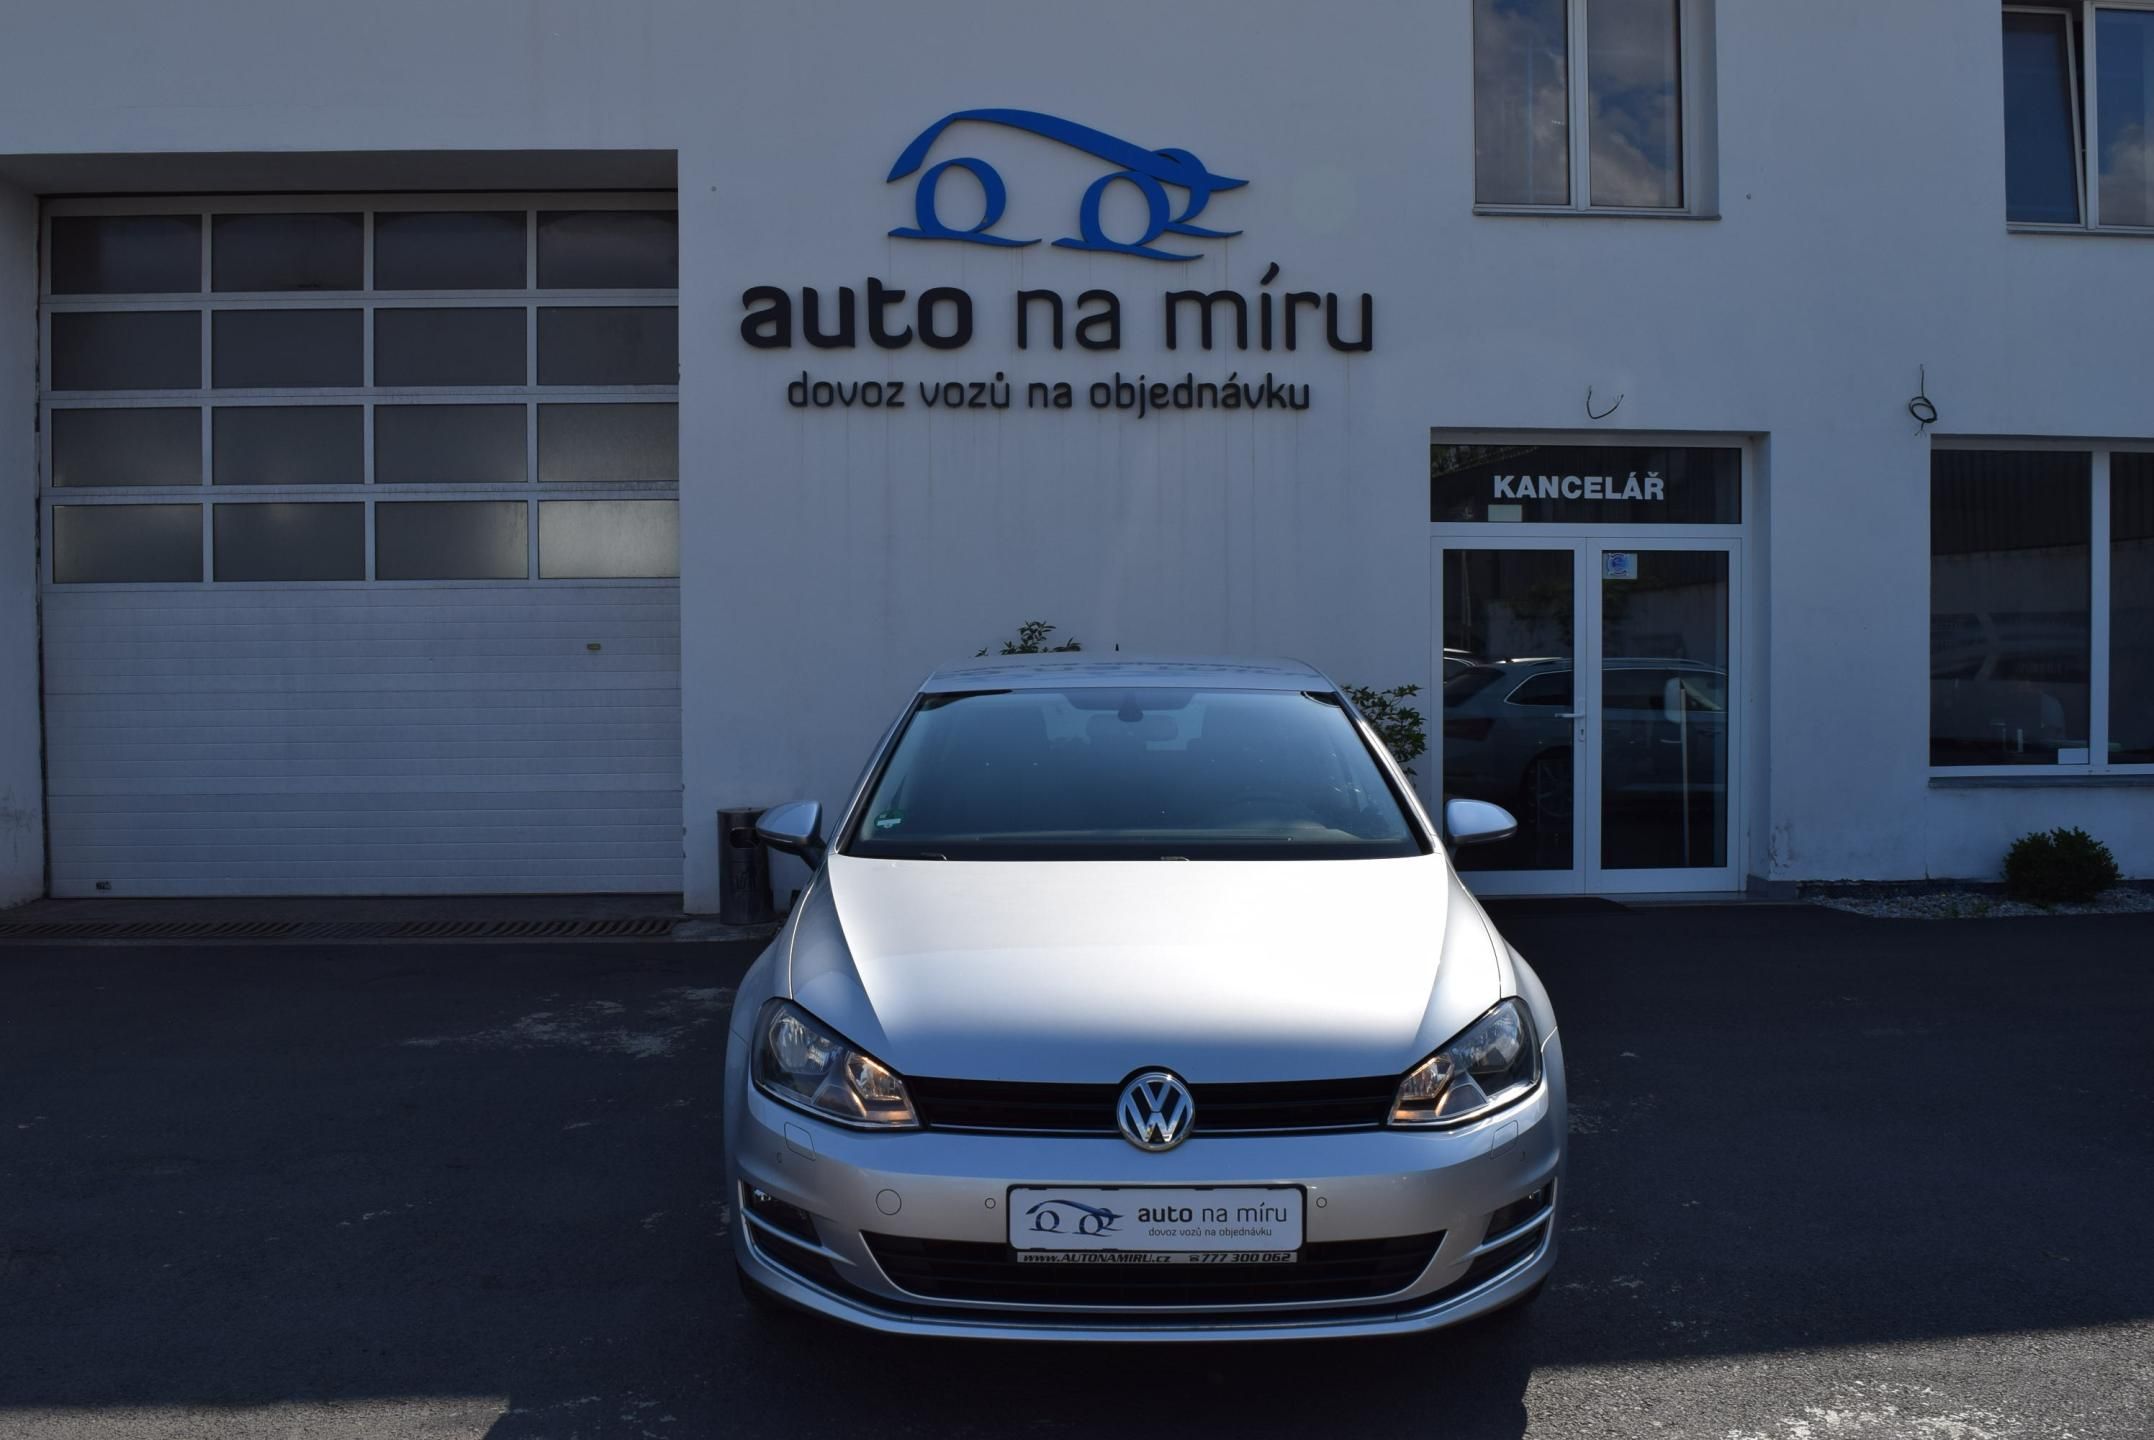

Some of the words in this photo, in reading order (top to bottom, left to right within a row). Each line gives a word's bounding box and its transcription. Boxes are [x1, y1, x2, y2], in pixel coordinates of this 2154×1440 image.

[740, 276, 973, 349] auto
[1016, 289, 1121, 350] na
[1165, 261, 1373, 352] míru
[787, 371, 905, 409] dovoz
[919, 371, 1010, 409] vozů
[1028, 378, 1072, 409] na
[1089, 372, 1310, 419] objednávku
[1493, 471, 1664, 500] KANCELÁŘ
[1120, 1076, 1191, 1146] VW
[1138, 1206, 1193, 1223] auto
[1202, 1207, 1228, 1223] na
[1237, 1202, 1287, 1223] míru
[1149, 1227, 1177, 1237] dovoz
[1205, 1229, 1216, 1237] na
[1219, 1227, 1272, 1238] objednávku
[1201, 1253, 1228, 1263] 777
[1231, 1253, 1260, 1263] 300
[1261, 1253, 1291, 1263] 062
